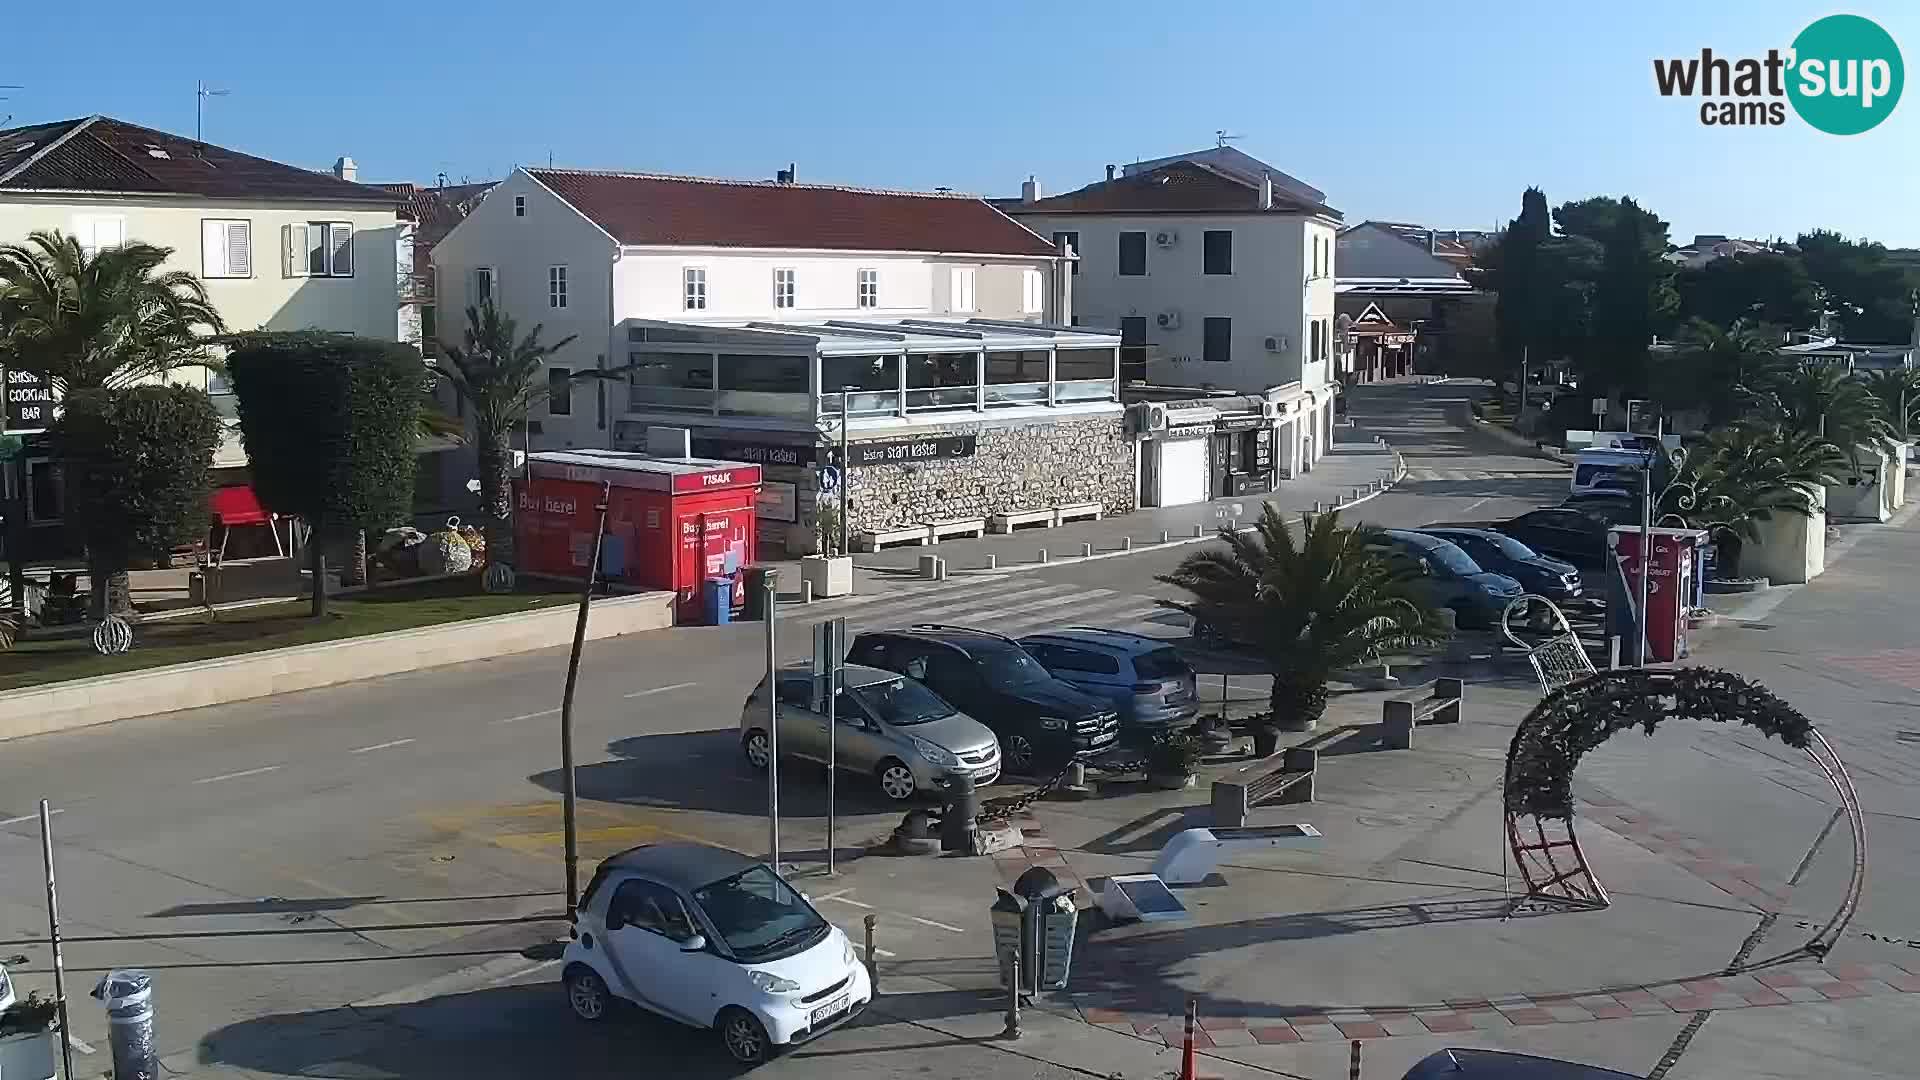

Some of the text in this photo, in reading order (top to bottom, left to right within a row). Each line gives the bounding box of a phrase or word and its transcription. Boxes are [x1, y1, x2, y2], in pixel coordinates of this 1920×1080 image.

[9, 388, 51, 402] COCKTAIL
[21, 407, 41, 420] BAR
[1170, 427, 1207, 437] MARKET
[702, 472, 732, 486] TISAK
[519, 492, 541, 513] Buy
[683, 521, 701, 535] Buy
